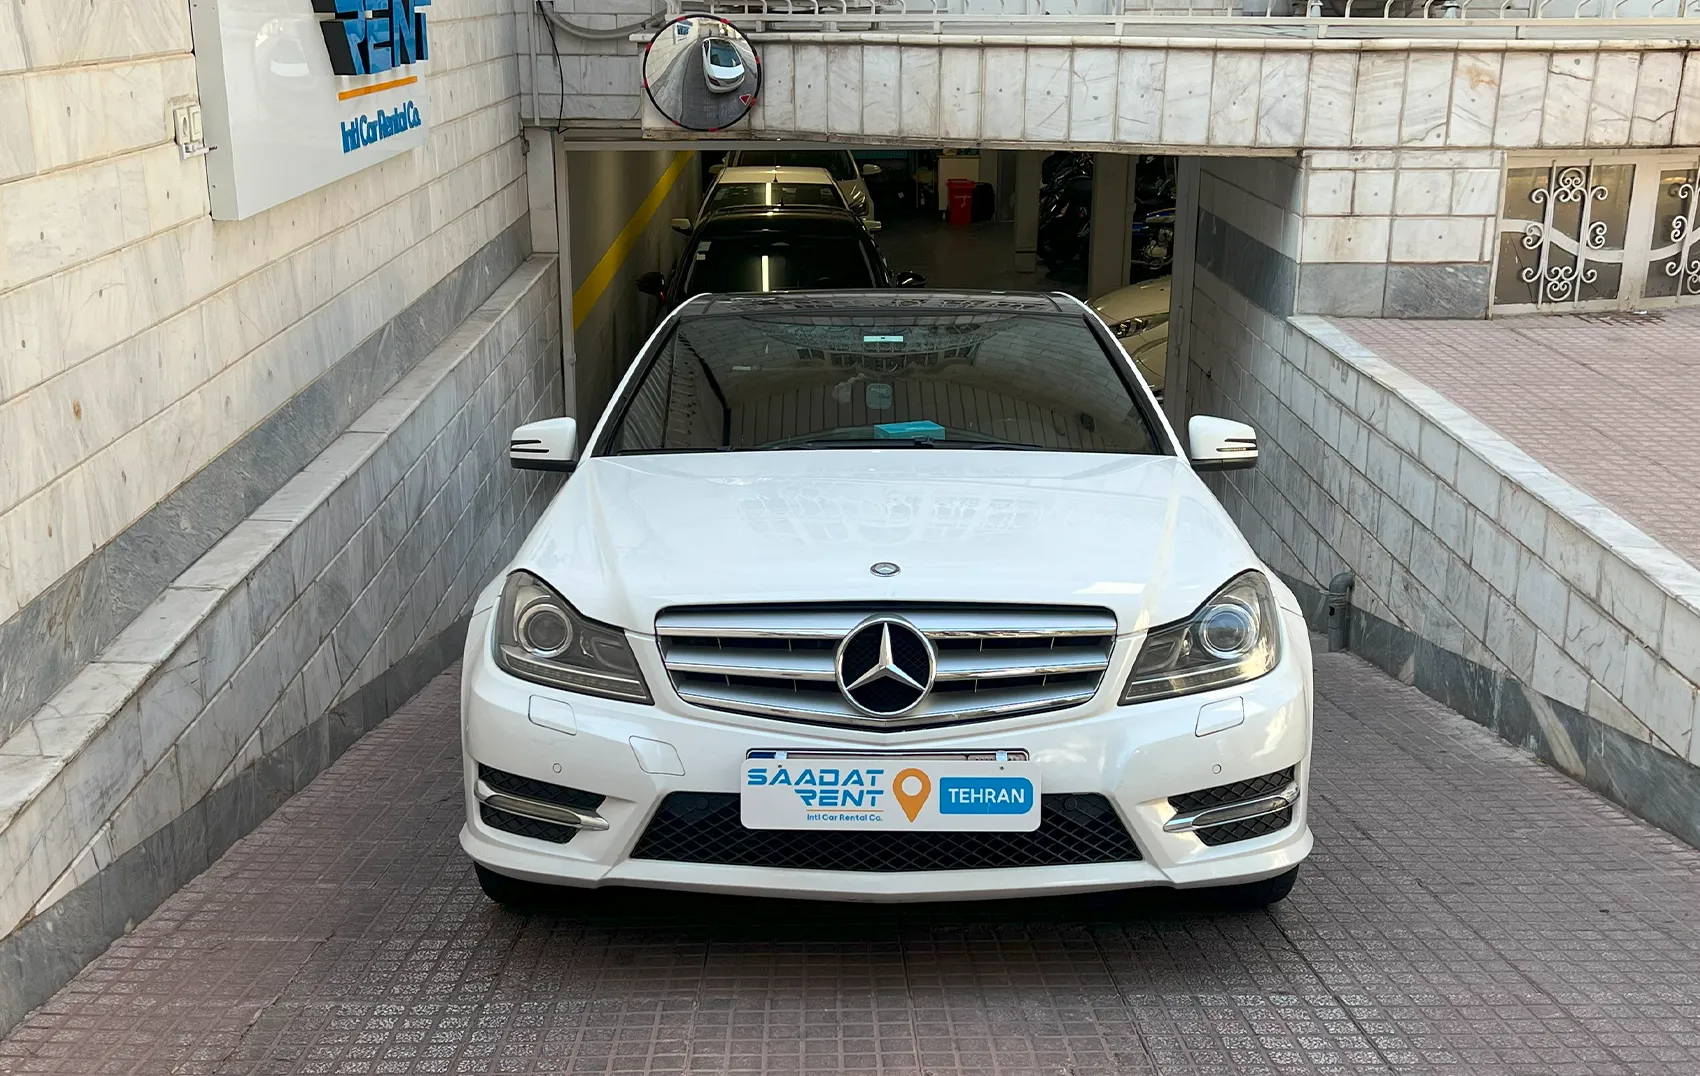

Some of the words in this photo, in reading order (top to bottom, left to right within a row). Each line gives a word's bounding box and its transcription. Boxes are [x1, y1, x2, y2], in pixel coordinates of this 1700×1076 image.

[324, 0, 431, 75] RENT
[360, 114, 378, 147] Car
[377, 102, 408, 140] Rental
[747, 768, 884, 787] SAADAT
[794, 788, 884, 807] RENT
[948, 788, 1025, 804] TEHRAN
[822, 813, 838, 821] Car
[839, 813, 868, 822] Rental
[869, 814, 883, 822] Co.
